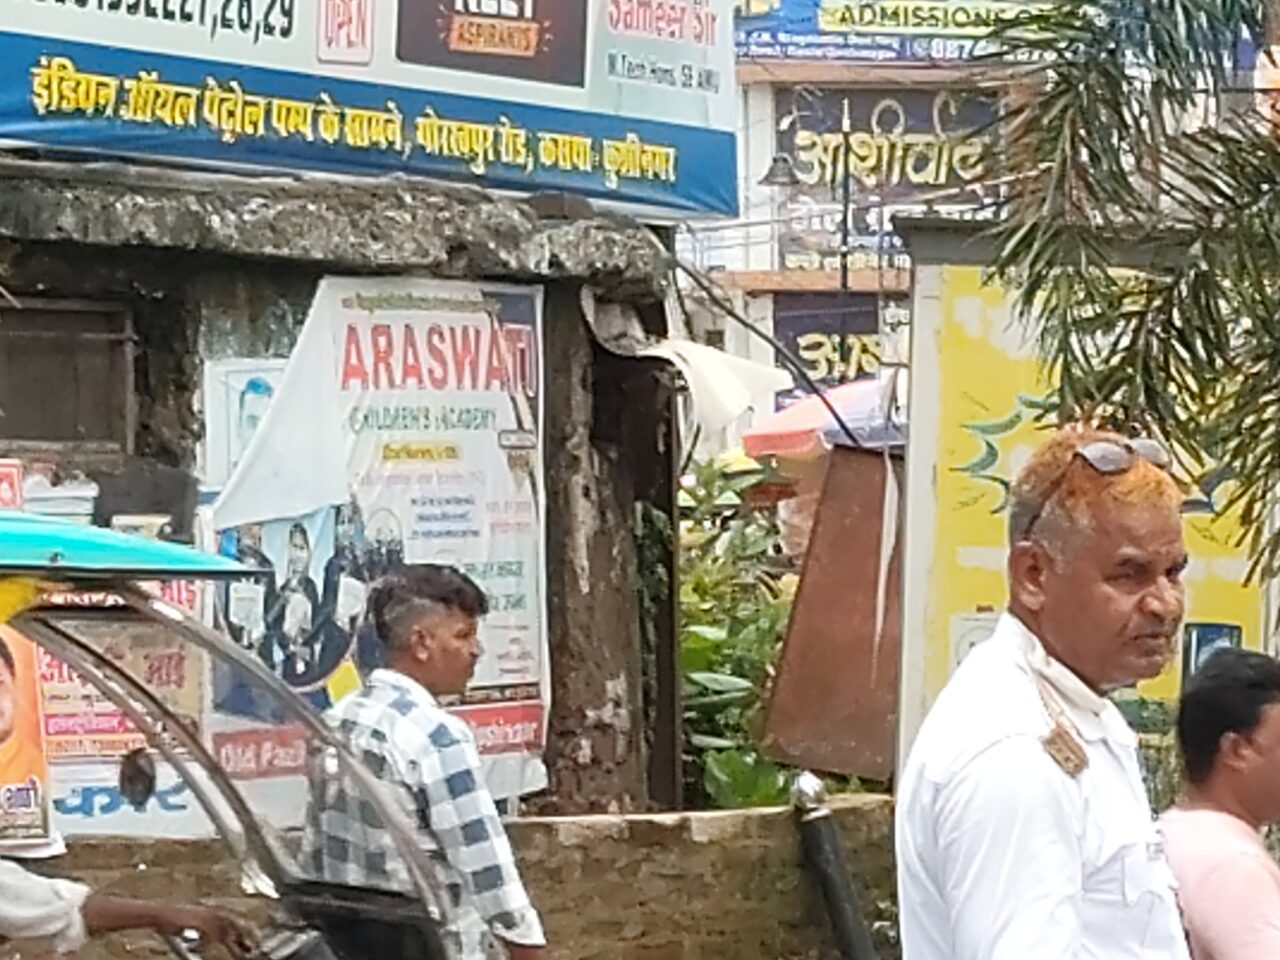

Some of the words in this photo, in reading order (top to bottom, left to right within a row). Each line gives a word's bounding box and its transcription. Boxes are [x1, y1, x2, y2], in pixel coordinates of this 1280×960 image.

[839, 3, 1003, 28] ADMISSION
[30, 54, 117, 117] इंडियन
[119, 71, 200, 128] ऑयल
[203, 75, 266, 144] पेट्रोल
[316, 92, 340, 146] के
[416, 105, 495, 175] गोरखपुर
[341, 323, 538, 397] ARASWATI
